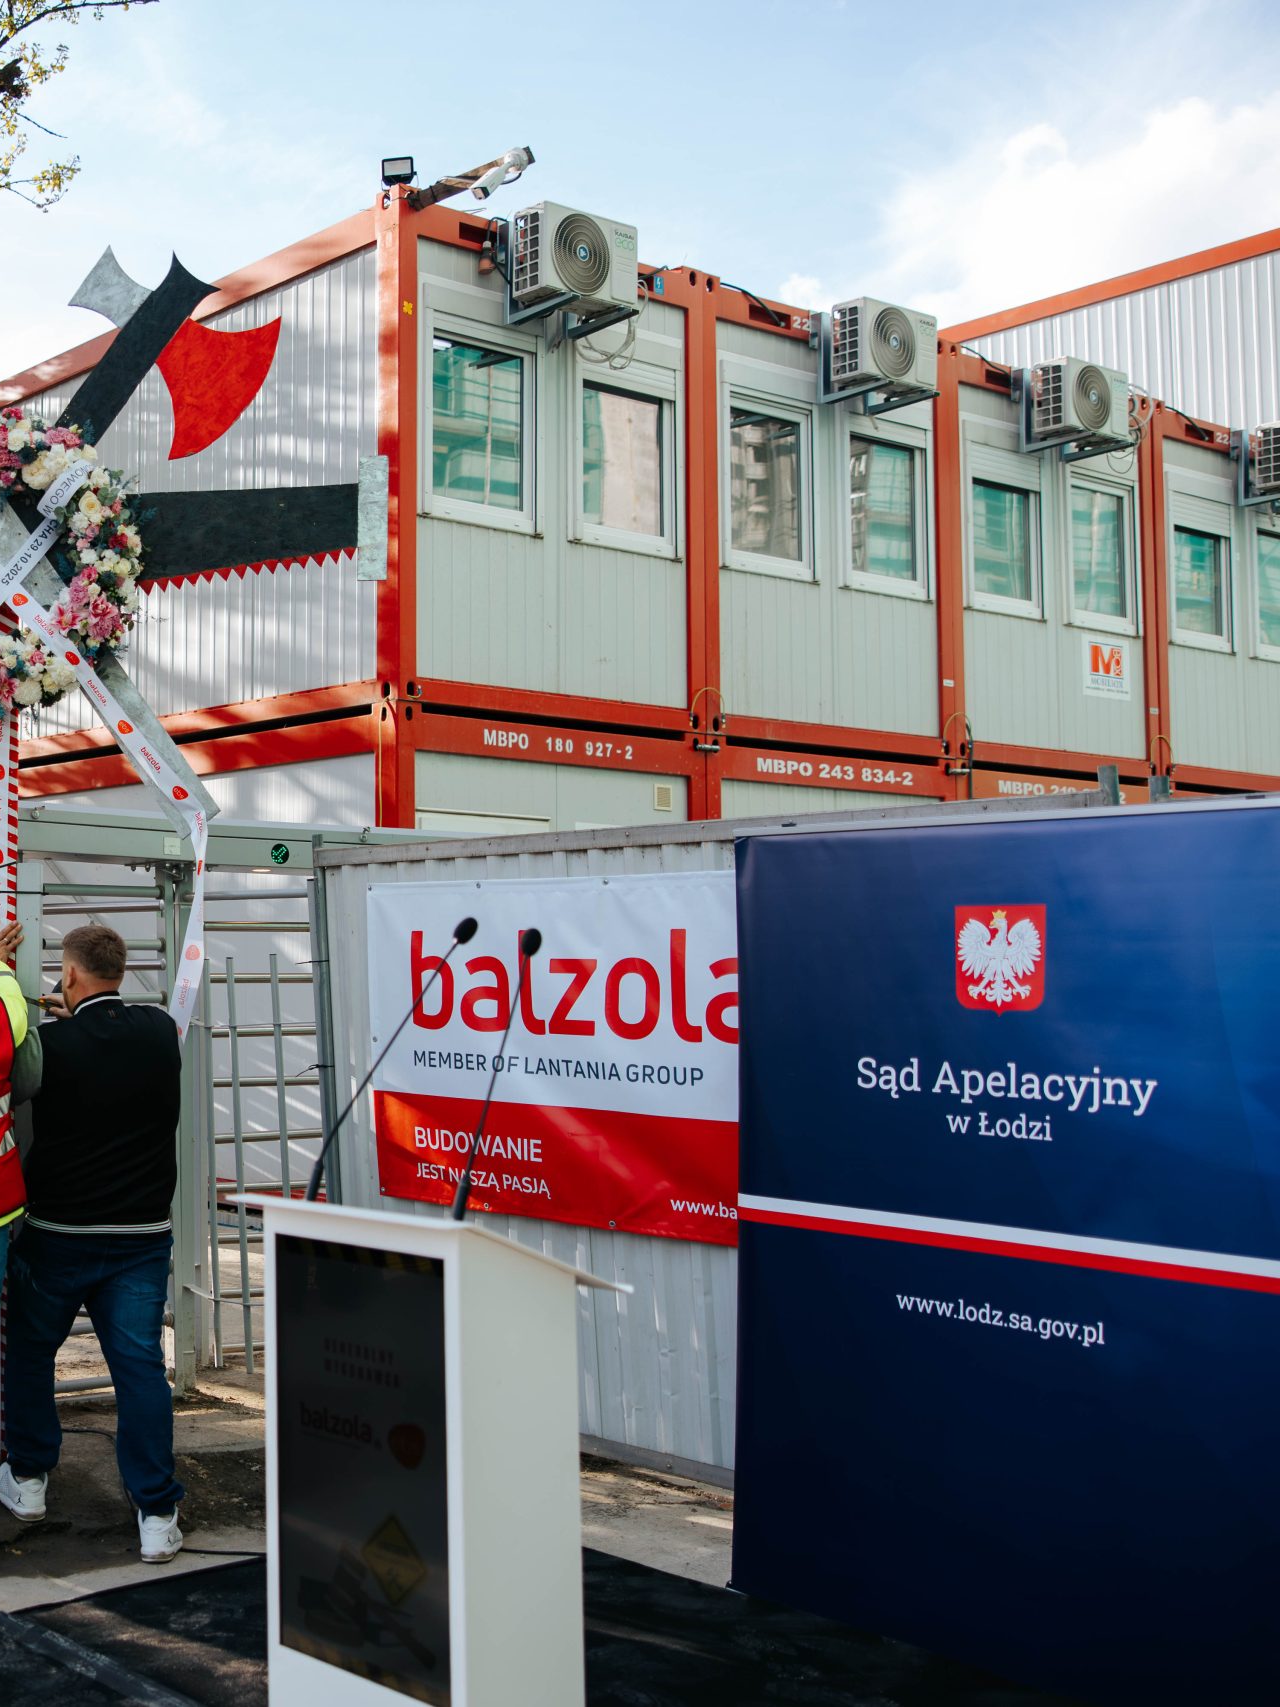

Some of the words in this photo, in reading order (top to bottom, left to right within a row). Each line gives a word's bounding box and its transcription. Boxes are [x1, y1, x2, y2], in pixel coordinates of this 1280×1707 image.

[1, 538, 43, 586] 29.10.2025
[141, 746, 161, 771] balzola
[483, 728, 529, 750] MBPO
[546, 737, 574, 753] 180
[585, 741, 633, 760] 927-2
[756, 757, 813, 777] MBPO
[818, 763, 854, 780] 243
[861, 767, 914, 786] 834-2
[998, 780, 1045, 796] MBPO
[410, 928, 739, 1045] balzola
[413, 1050, 488, 1072] MEMBER
[491, 1055, 519, 1073] OF
[524, 1057, 621, 1082] LANTANIA
[626, 1063, 704, 1087] GROUP
[857, 1056, 921, 1099] Sąd
[932, 1060, 1158, 1117] Apelacyjny
[414, 1126, 543, 1163] BUDOWANIE
[946, 1114, 971, 1135] w
[978, 1111, 1053, 1142] Łodzi
[416, 1162, 446, 1182] JEST
[502, 1176, 552, 1200] PASJĄ
[896, 1294, 1105, 1347] www.lodz.sa.gov.pl
[300, 1401, 372, 1443] balzola
